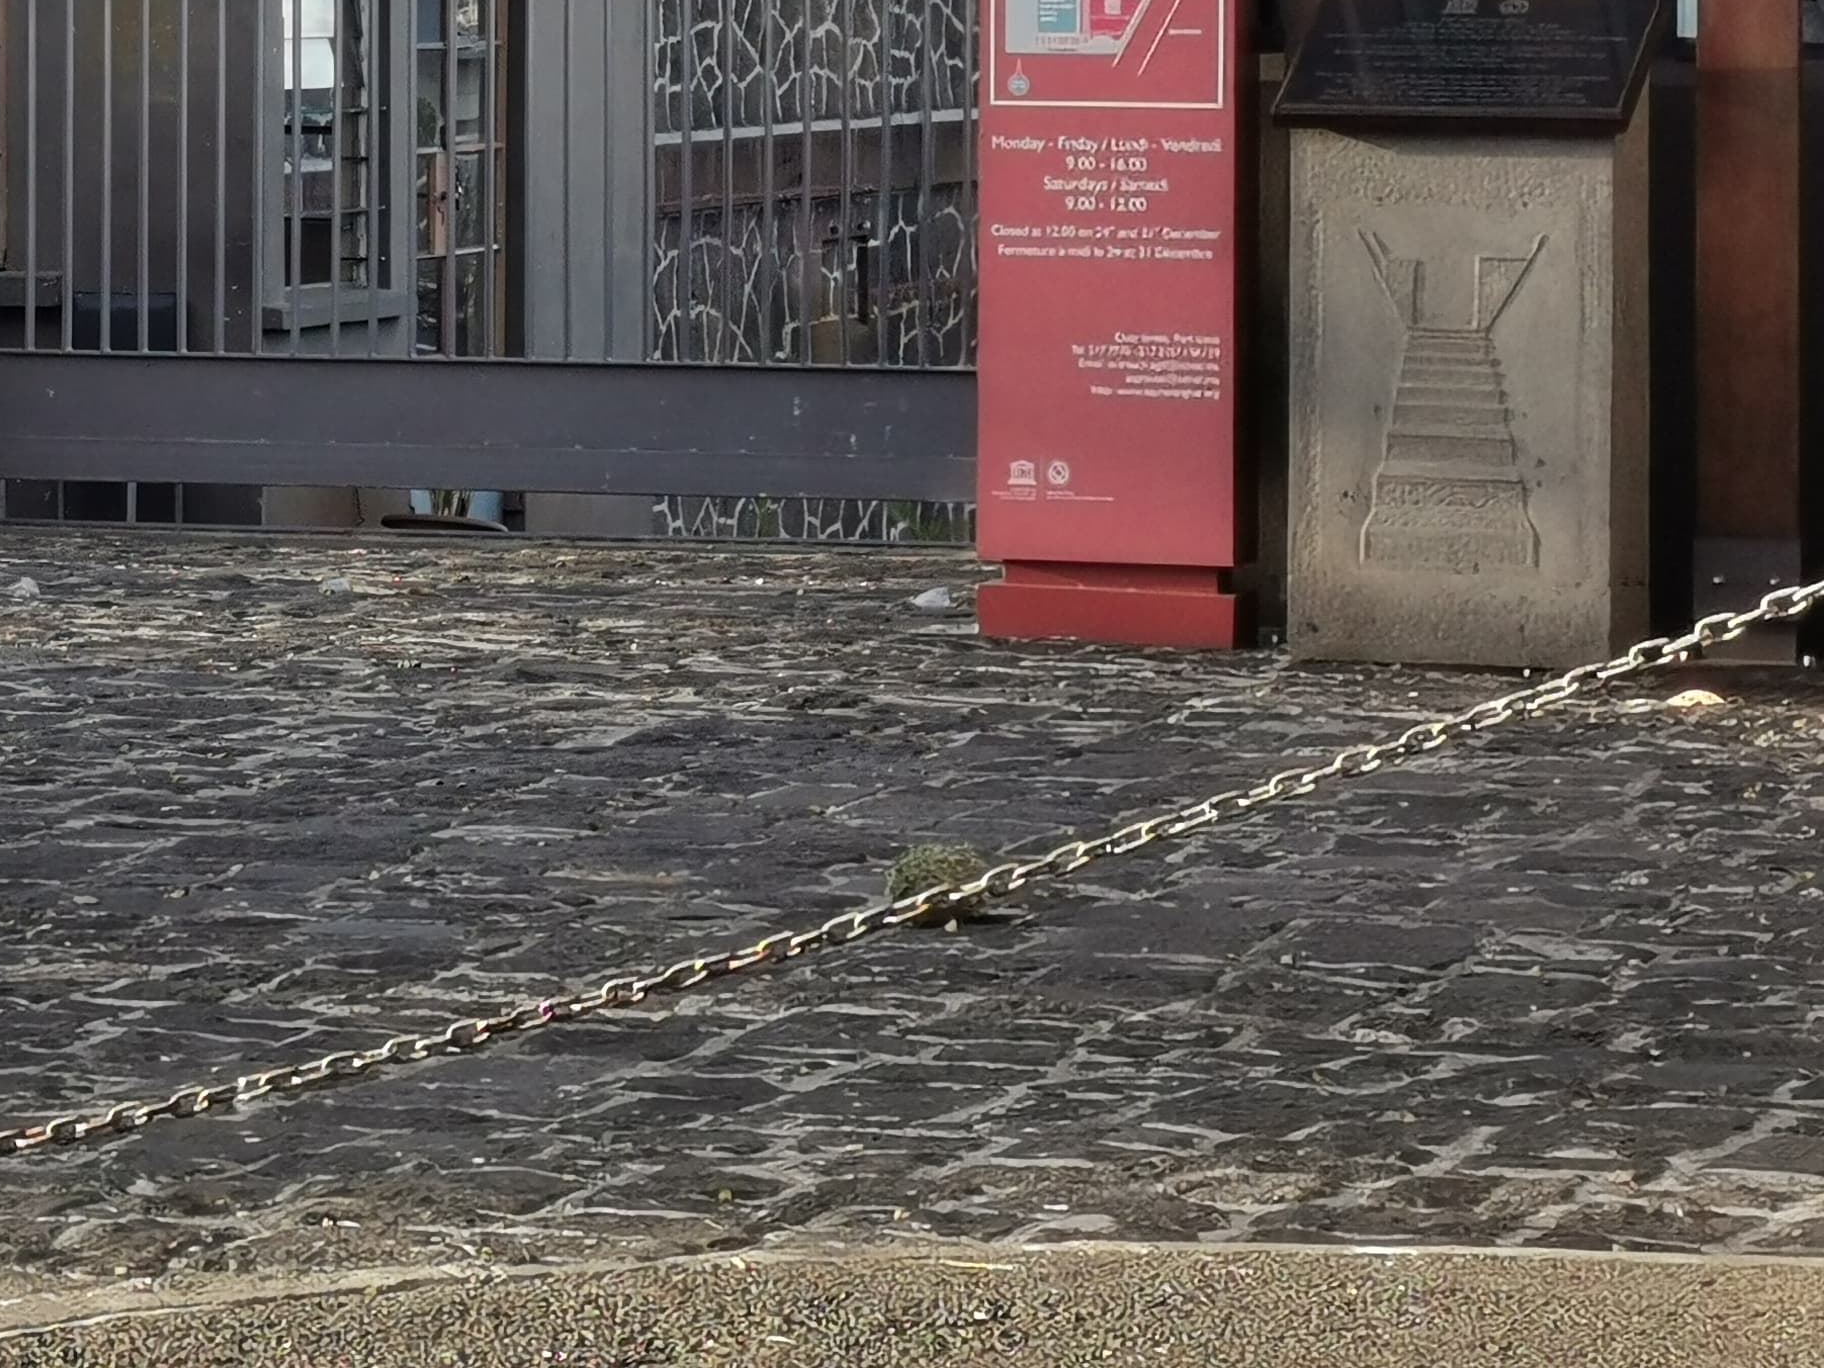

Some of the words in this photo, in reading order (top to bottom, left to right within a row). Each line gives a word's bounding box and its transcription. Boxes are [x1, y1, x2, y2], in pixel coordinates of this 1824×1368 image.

[991, 136, 1045, 153] Monday
[1057, 136, 1098, 153] Friday
[1065, 155, 1096, 171] 9.00
[1110, 156, 1147, 172] 16.00
[1043, 175, 1108, 196] Saturdays
[1065, 196, 1096, 211] 9.00
[1110, 196, 1147, 212] 12.00
[990, 224, 1029, 237] Closed
[1046, 225, 1076, 238] 12.00
